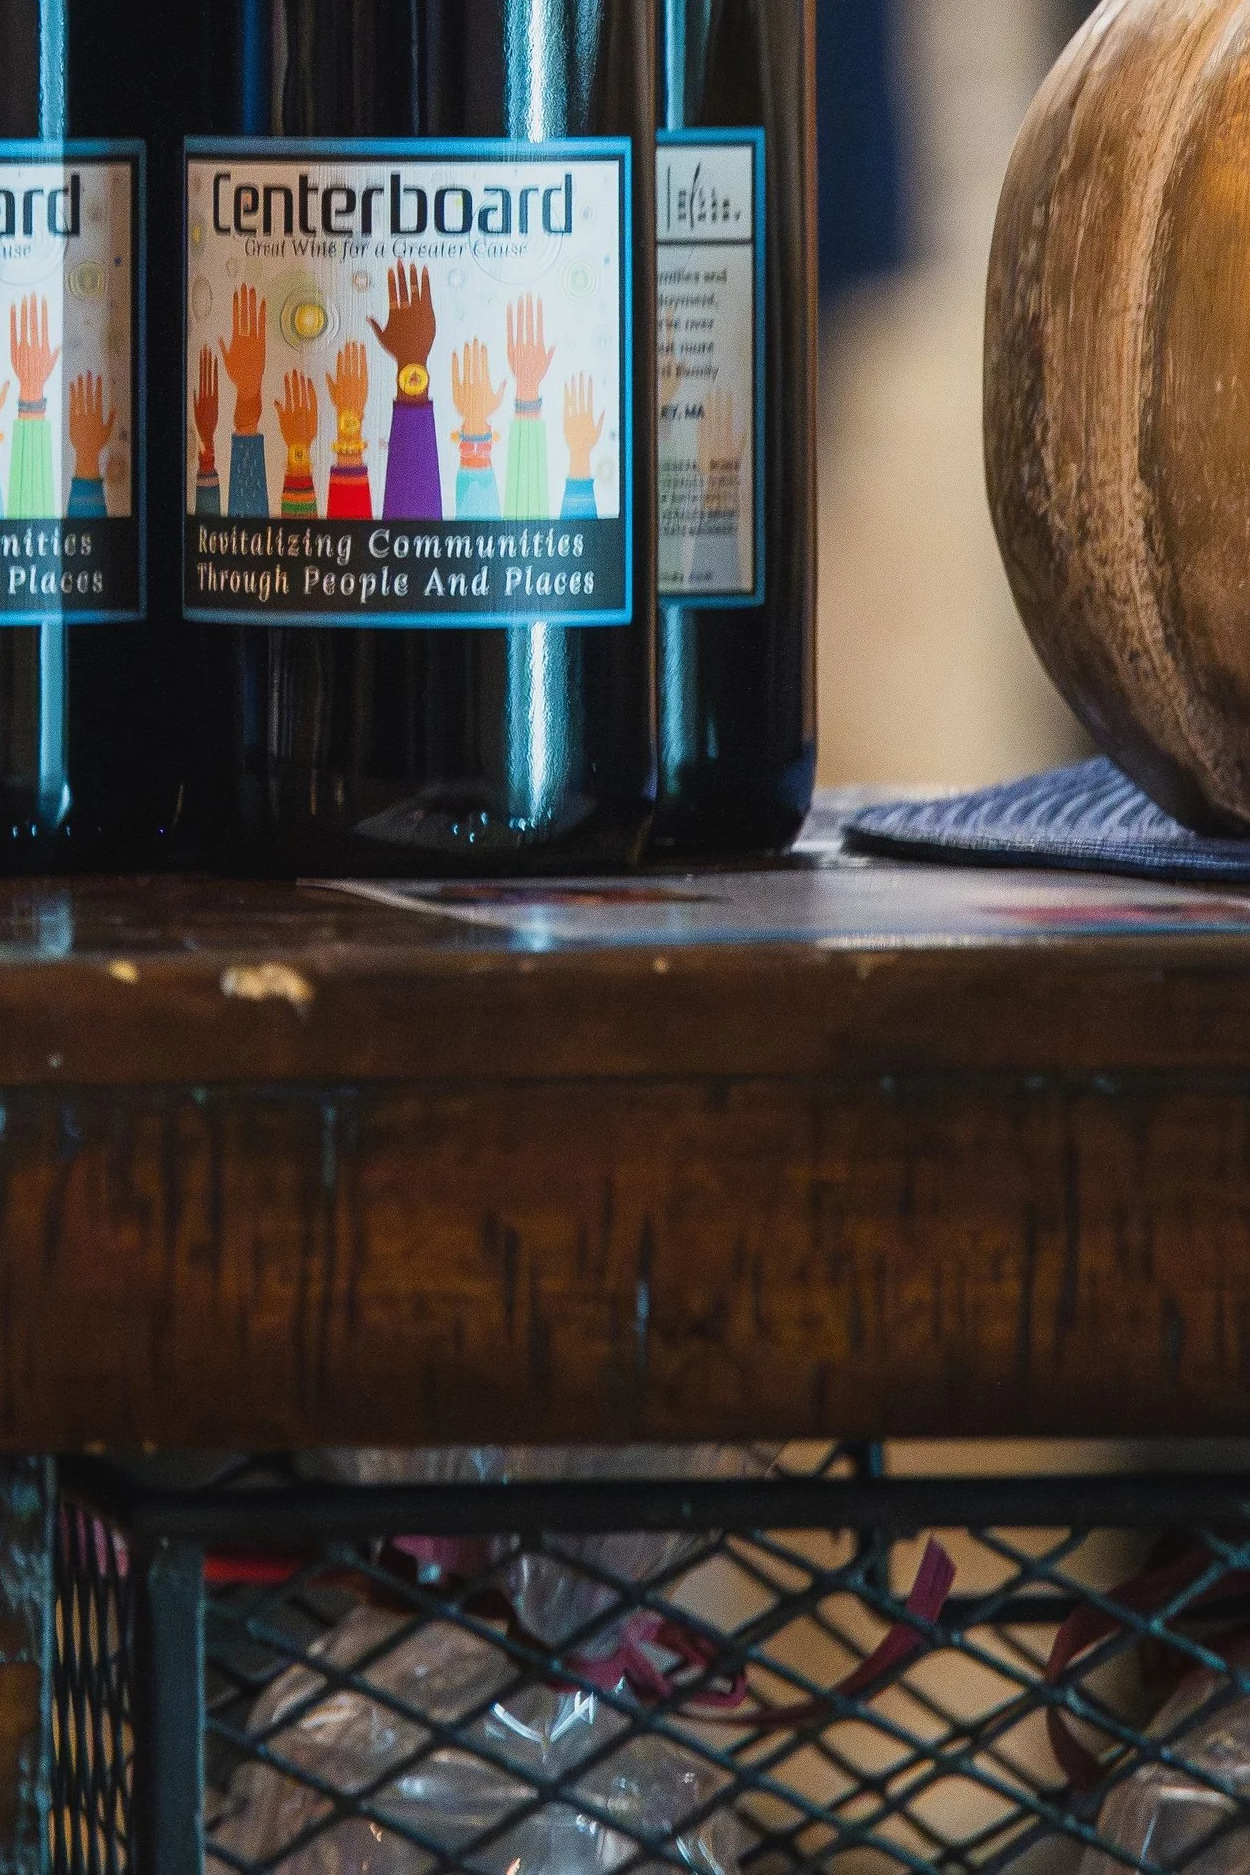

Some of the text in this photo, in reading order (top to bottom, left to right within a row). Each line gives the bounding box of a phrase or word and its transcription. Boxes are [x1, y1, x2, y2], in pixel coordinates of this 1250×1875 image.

[213, 171, 574, 237] Centerboard
[245, 237, 528, 262] Great Wine for a Greater Cause
[199, 525, 585, 566] Revitalizing Communities
[9, 565, 105, 595] Places
[198, 562, 596, 603] Through People And Places
